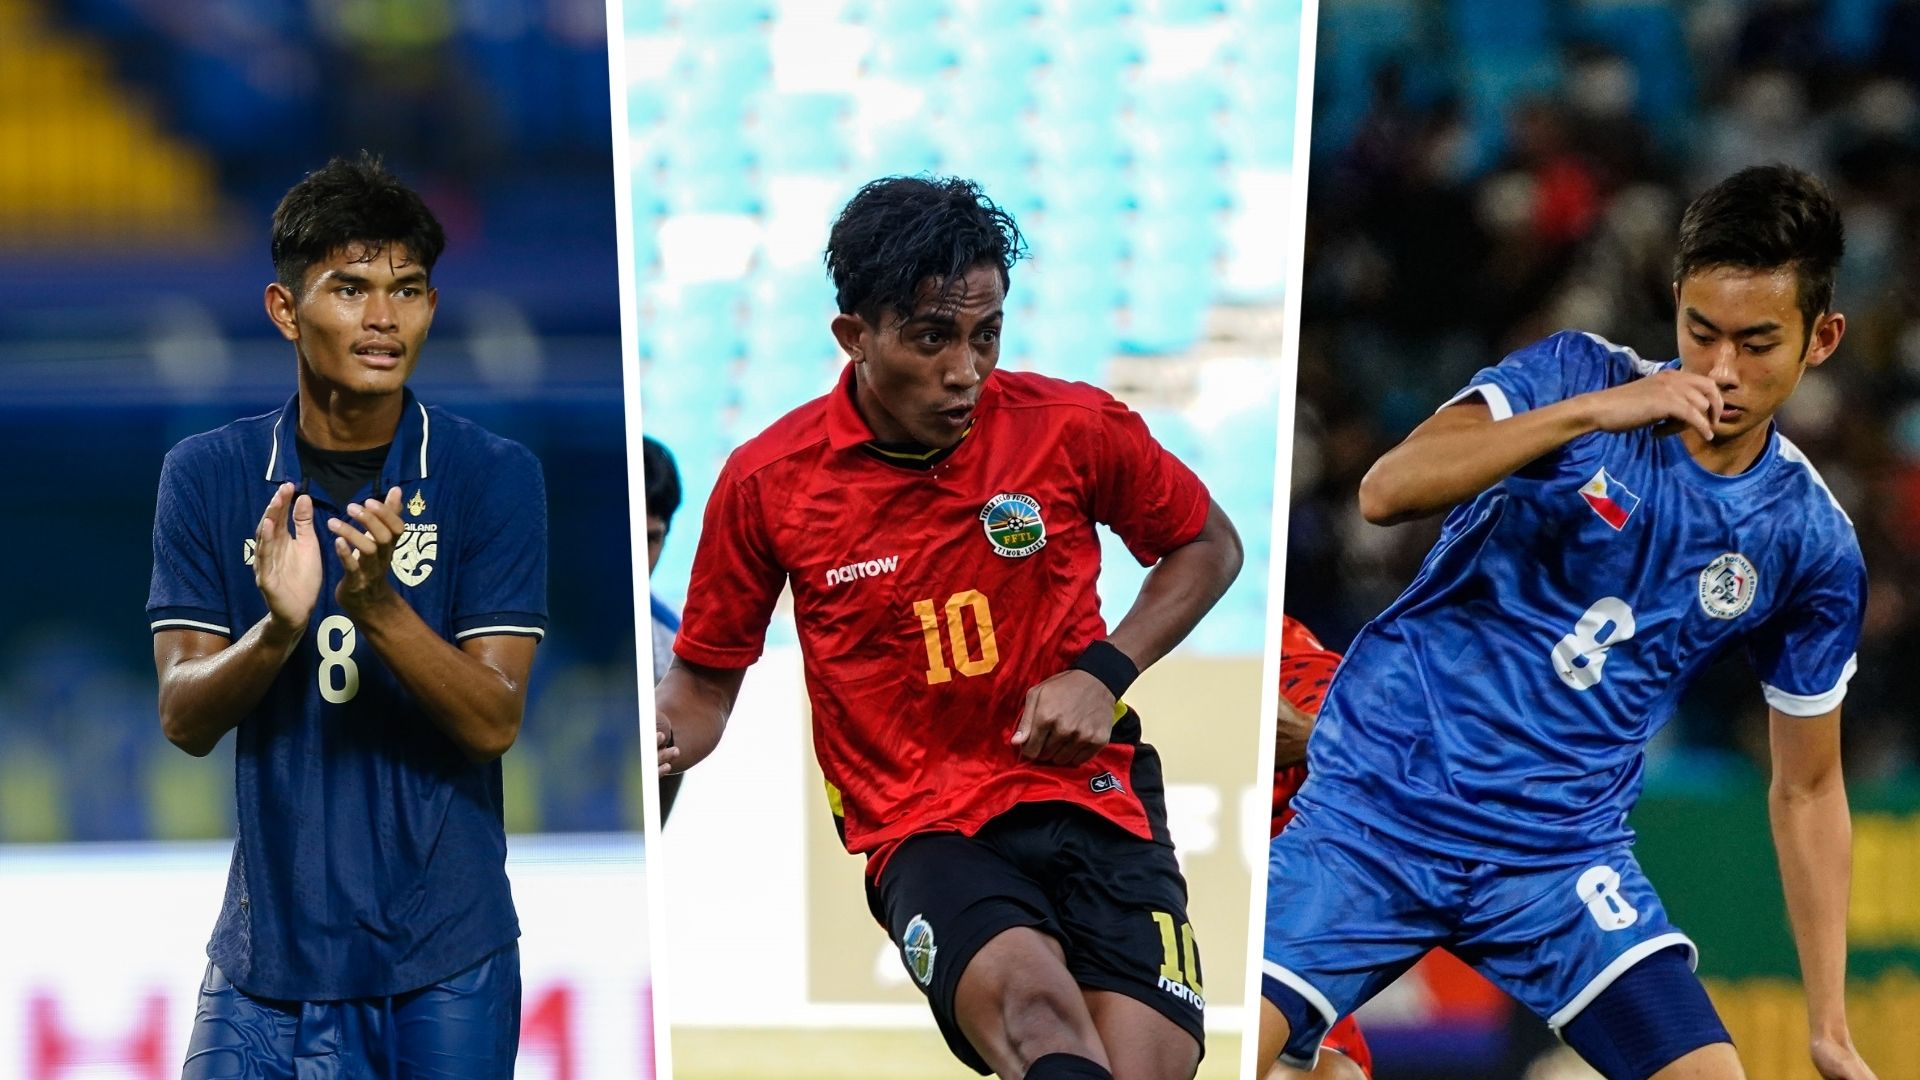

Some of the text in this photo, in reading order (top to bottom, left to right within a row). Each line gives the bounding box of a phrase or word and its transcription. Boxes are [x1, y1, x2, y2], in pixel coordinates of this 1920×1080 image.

[403, 522, 438, 532] AILAND
[1003, 532, 1035, 545] FFTL
[826, 555, 899, 586] narrow
[316, 614, 359, 704] 8
[913, 589, 1000, 685] 10
[1550, 596, 1636, 691] 8
[1575, 865, 1639, 932] 8
[1157, 975, 1206, 1011] narro
